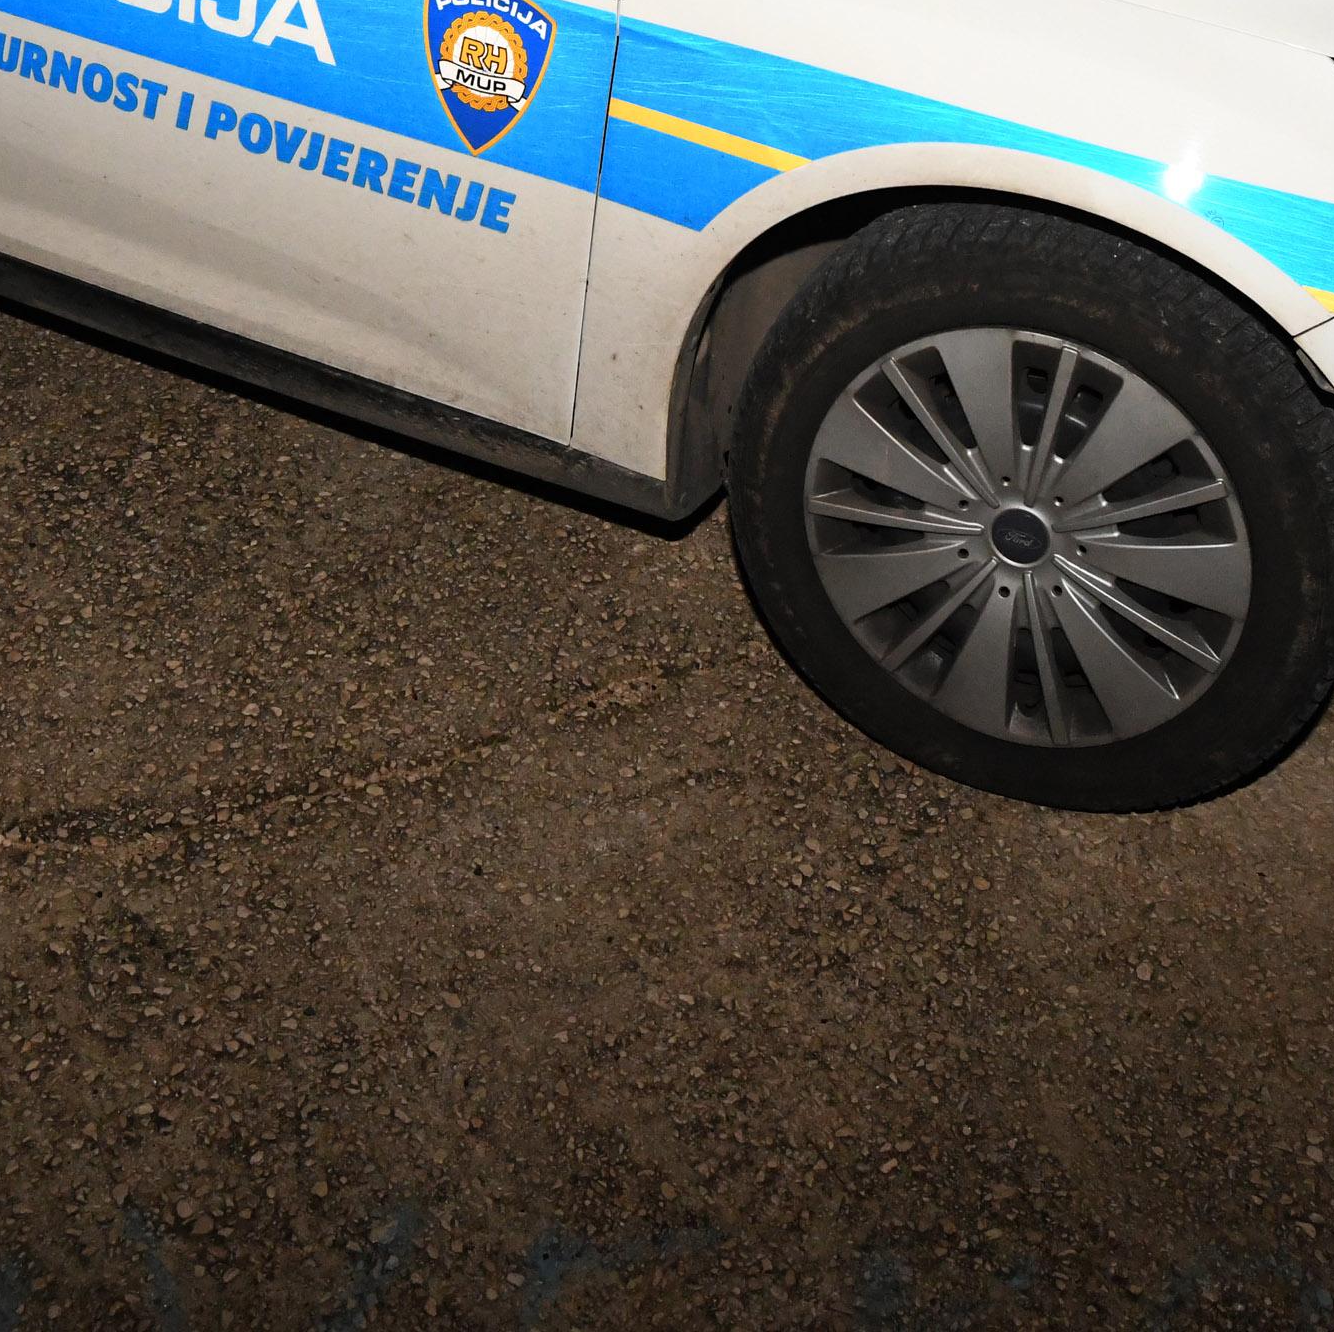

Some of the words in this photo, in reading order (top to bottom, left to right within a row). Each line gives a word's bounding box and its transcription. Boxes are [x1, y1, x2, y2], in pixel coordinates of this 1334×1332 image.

[459, 36, 508, 75] RH
[455, 69, 507, 93] MUP
[176, 91, 194, 130] I
[204, 101, 516, 234] POVJERENJE
[1003, 530, 1036, 548] Ford
